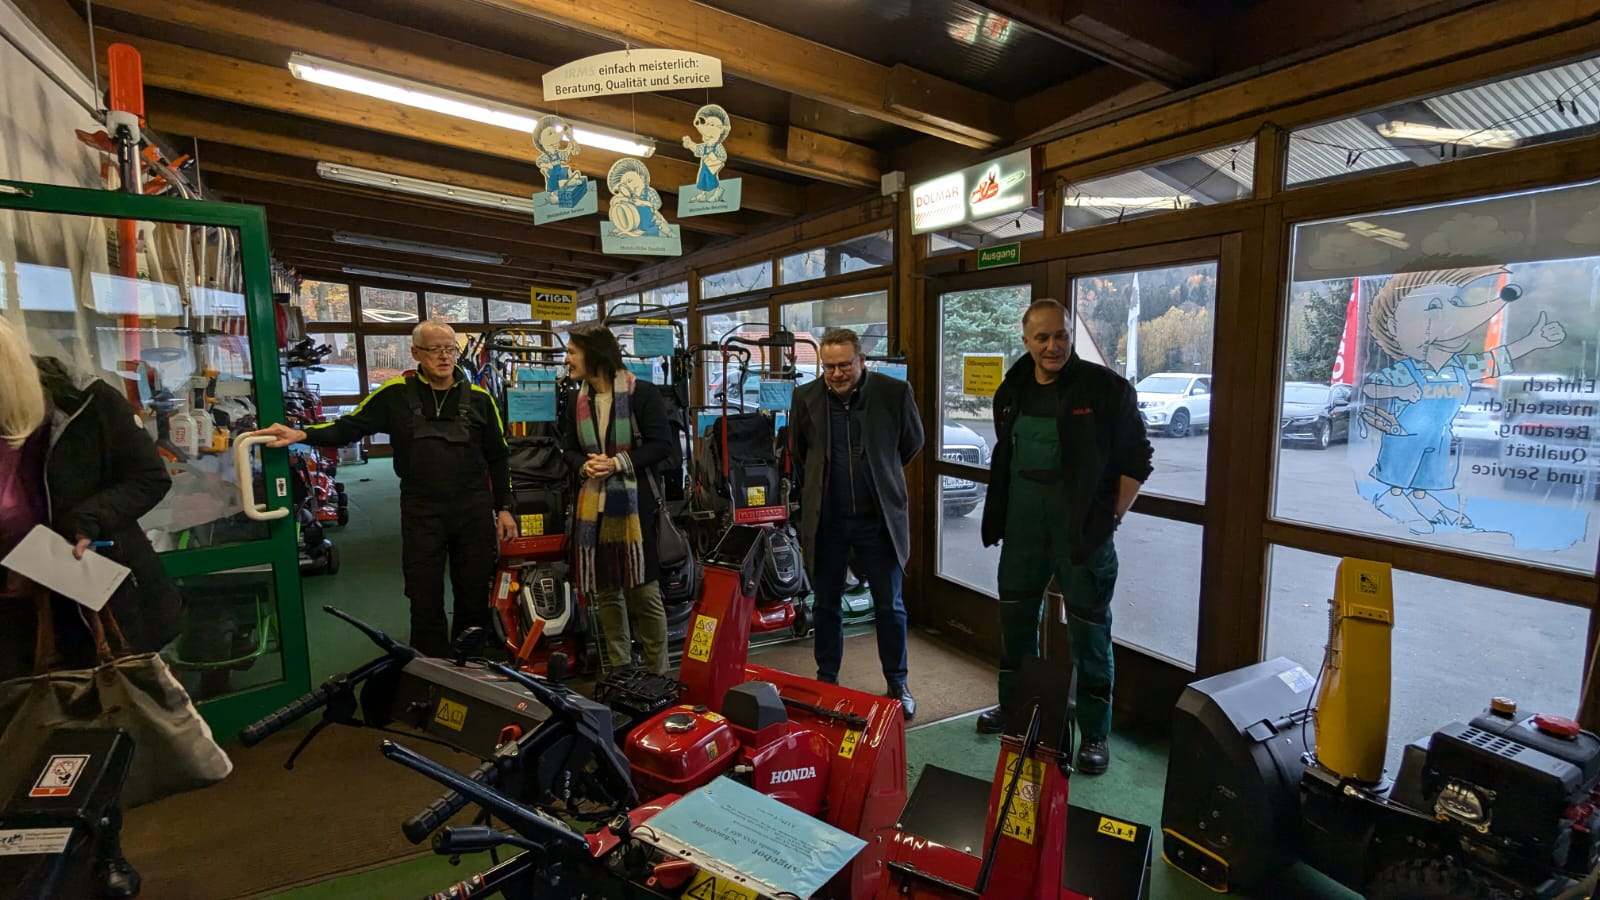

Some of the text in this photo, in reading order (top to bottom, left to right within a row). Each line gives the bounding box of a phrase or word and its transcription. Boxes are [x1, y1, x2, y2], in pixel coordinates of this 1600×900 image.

[598, 63, 636, 76] einfach
[639, 58, 700, 72] meisterlich:
[555, 73, 710, 96] Beratung, Qualität und Service
[916, 186, 960, 208] DOLMAR
[981, 248, 1016, 262] Ausgang
[536, 293, 571, 304] STIGA
[769, 766, 817, 785] HONDA
[752, 848, 802, 873] Angebot
